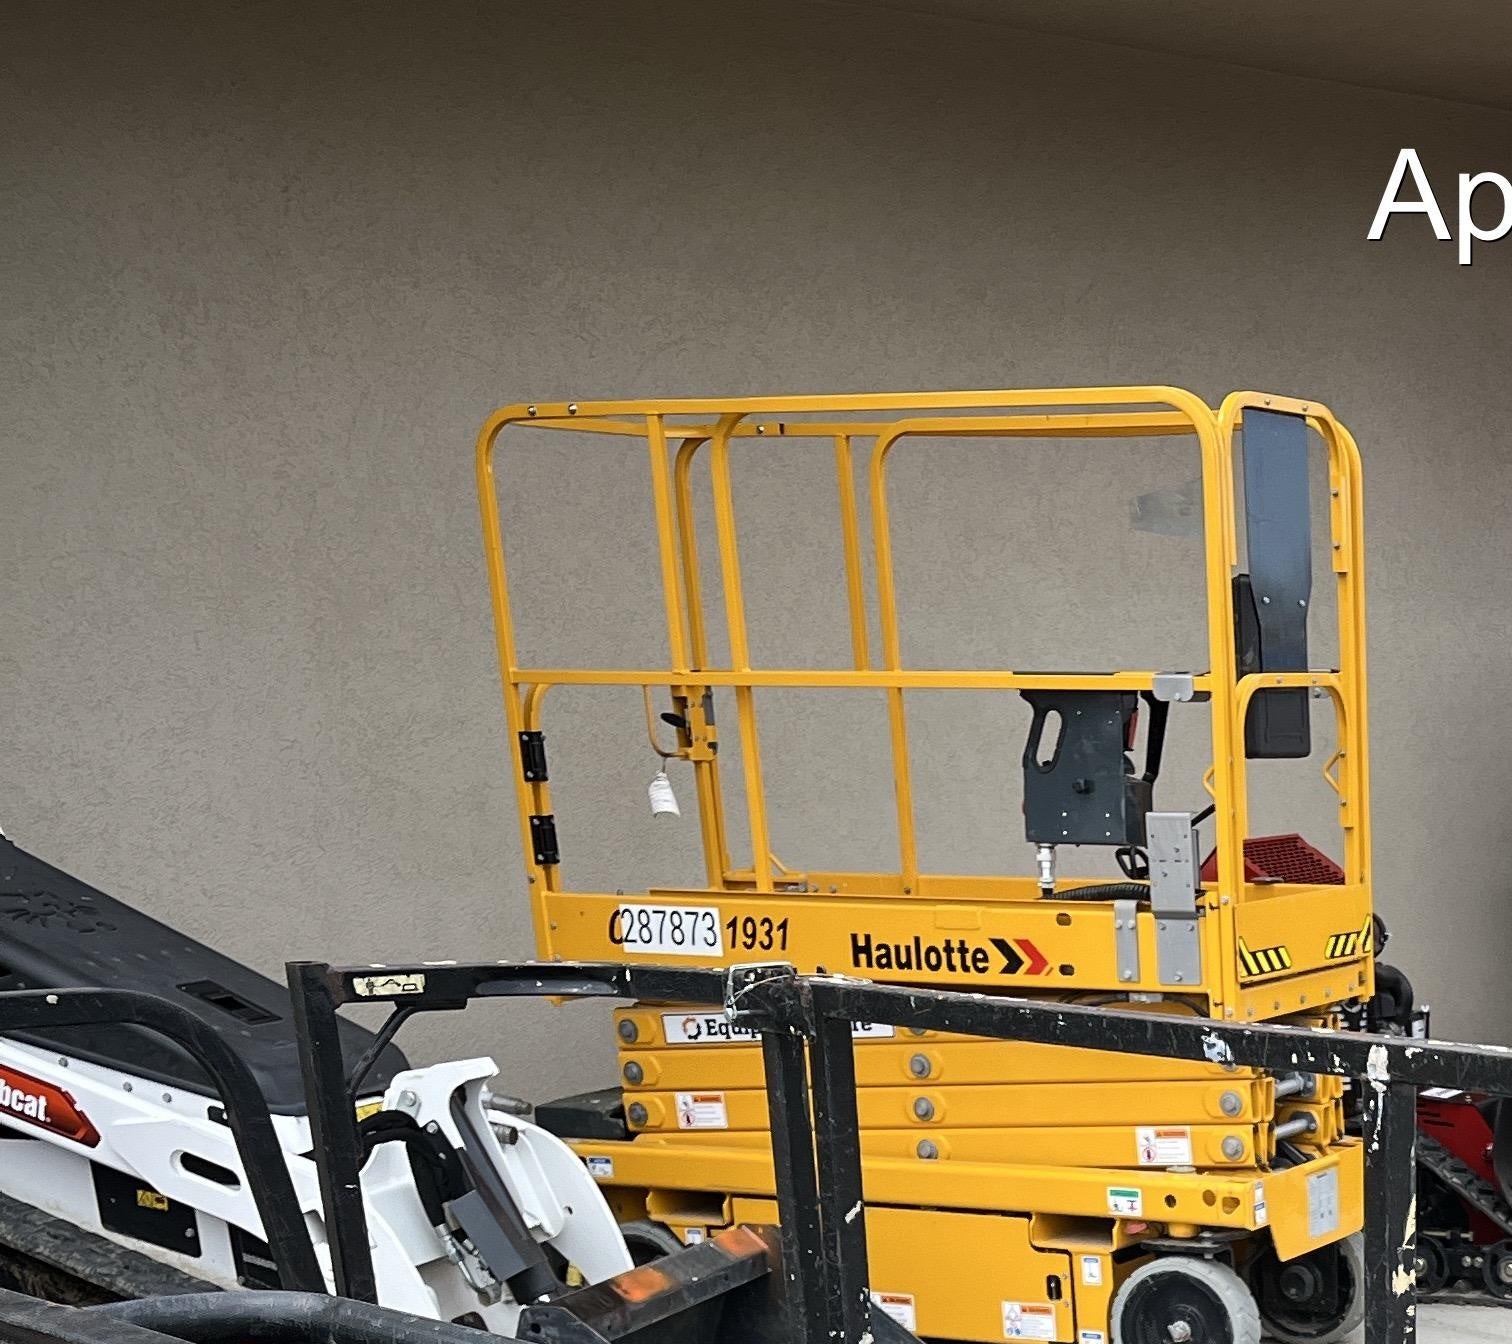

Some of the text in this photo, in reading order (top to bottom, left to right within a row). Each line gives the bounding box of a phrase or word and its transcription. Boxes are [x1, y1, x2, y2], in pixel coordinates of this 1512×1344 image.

[620, 907, 718, 947] 287873
[725, 915, 789, 951] 1931
[850, 933, 990, 975] Haulotte
[0, 1077, 48, 1122] bcat
